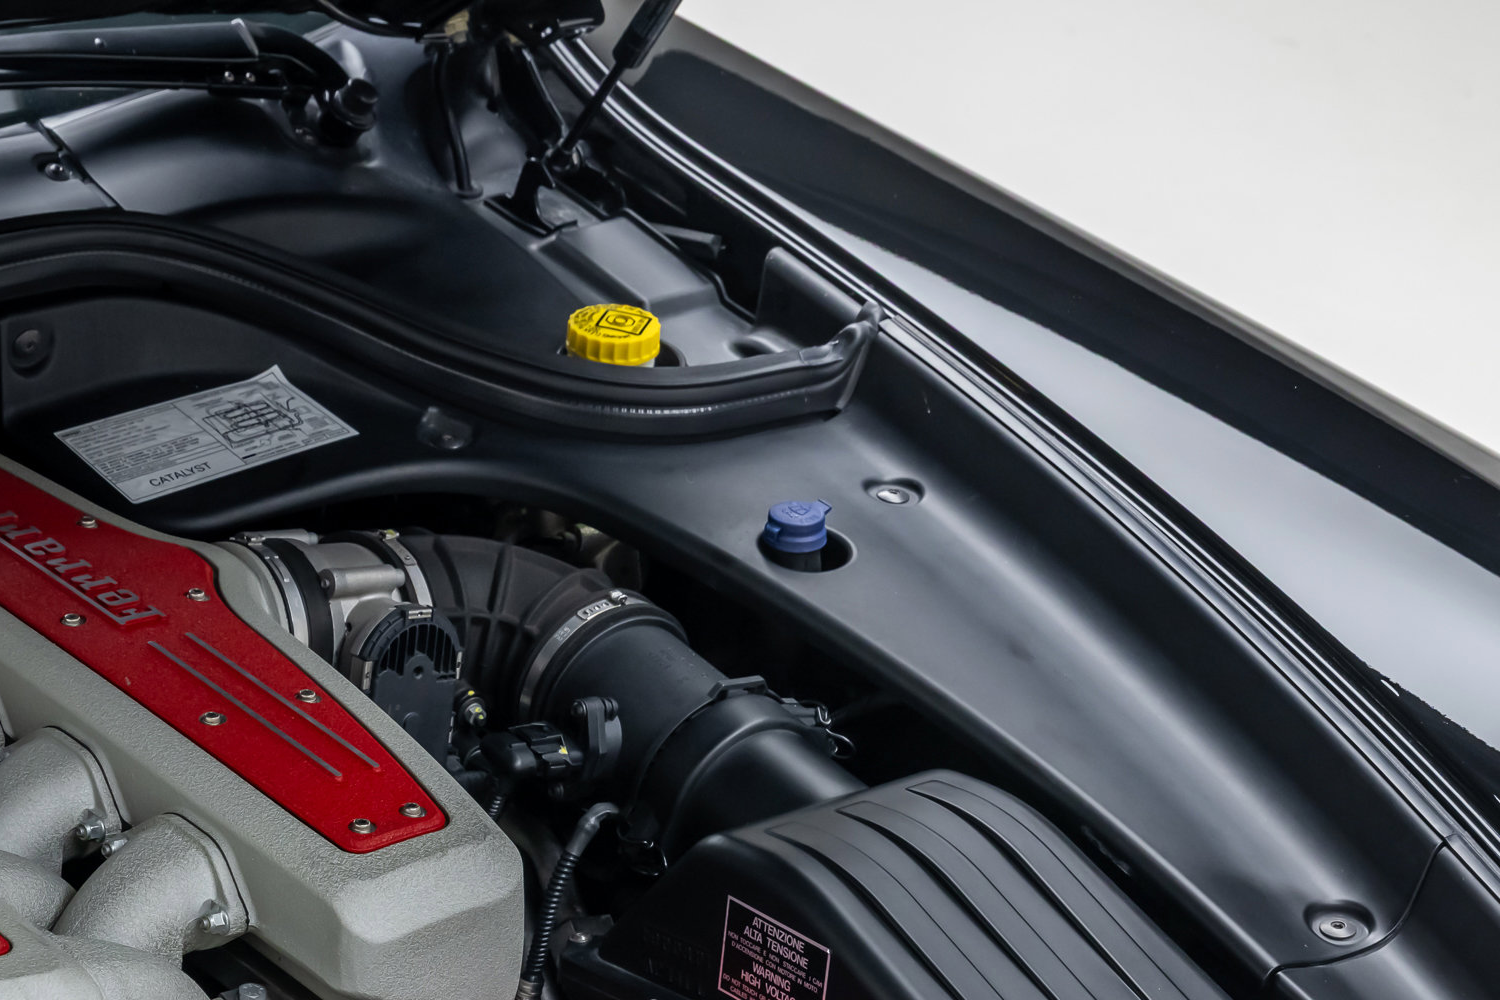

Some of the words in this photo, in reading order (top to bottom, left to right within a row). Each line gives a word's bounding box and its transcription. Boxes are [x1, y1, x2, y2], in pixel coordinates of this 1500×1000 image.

[149, 461, 212, 487] CATALYST
[743, 924, 762, 944] ALTA
[766, 936, 808, 970] TENSIONE
[752, 915, 804, 953] ATTENZIONE
[740, 968, 761, 989] HIGH
[741, 983, 757, 997] TOUCH
[751, 961, 791, 992] WARNING
